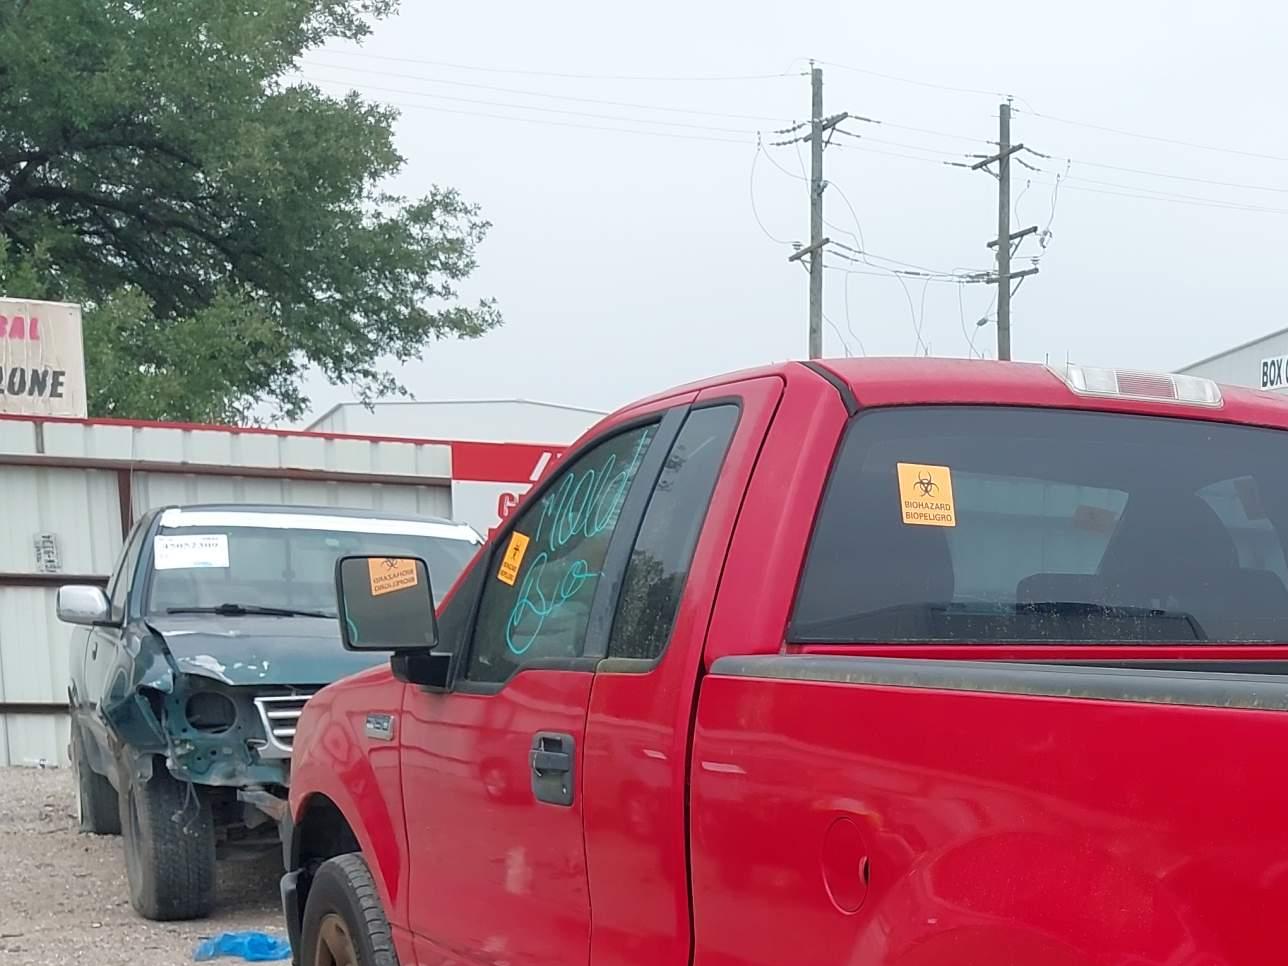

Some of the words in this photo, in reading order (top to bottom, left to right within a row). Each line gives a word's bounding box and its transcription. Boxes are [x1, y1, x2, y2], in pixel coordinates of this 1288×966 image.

[0, 365, 66, 398] ONE
[1261, 358, 1283, 388] BOX
[904, 500, 951, 511] BIOHAZARD
[905, 511, 953, 522] BIOPELIGRO
